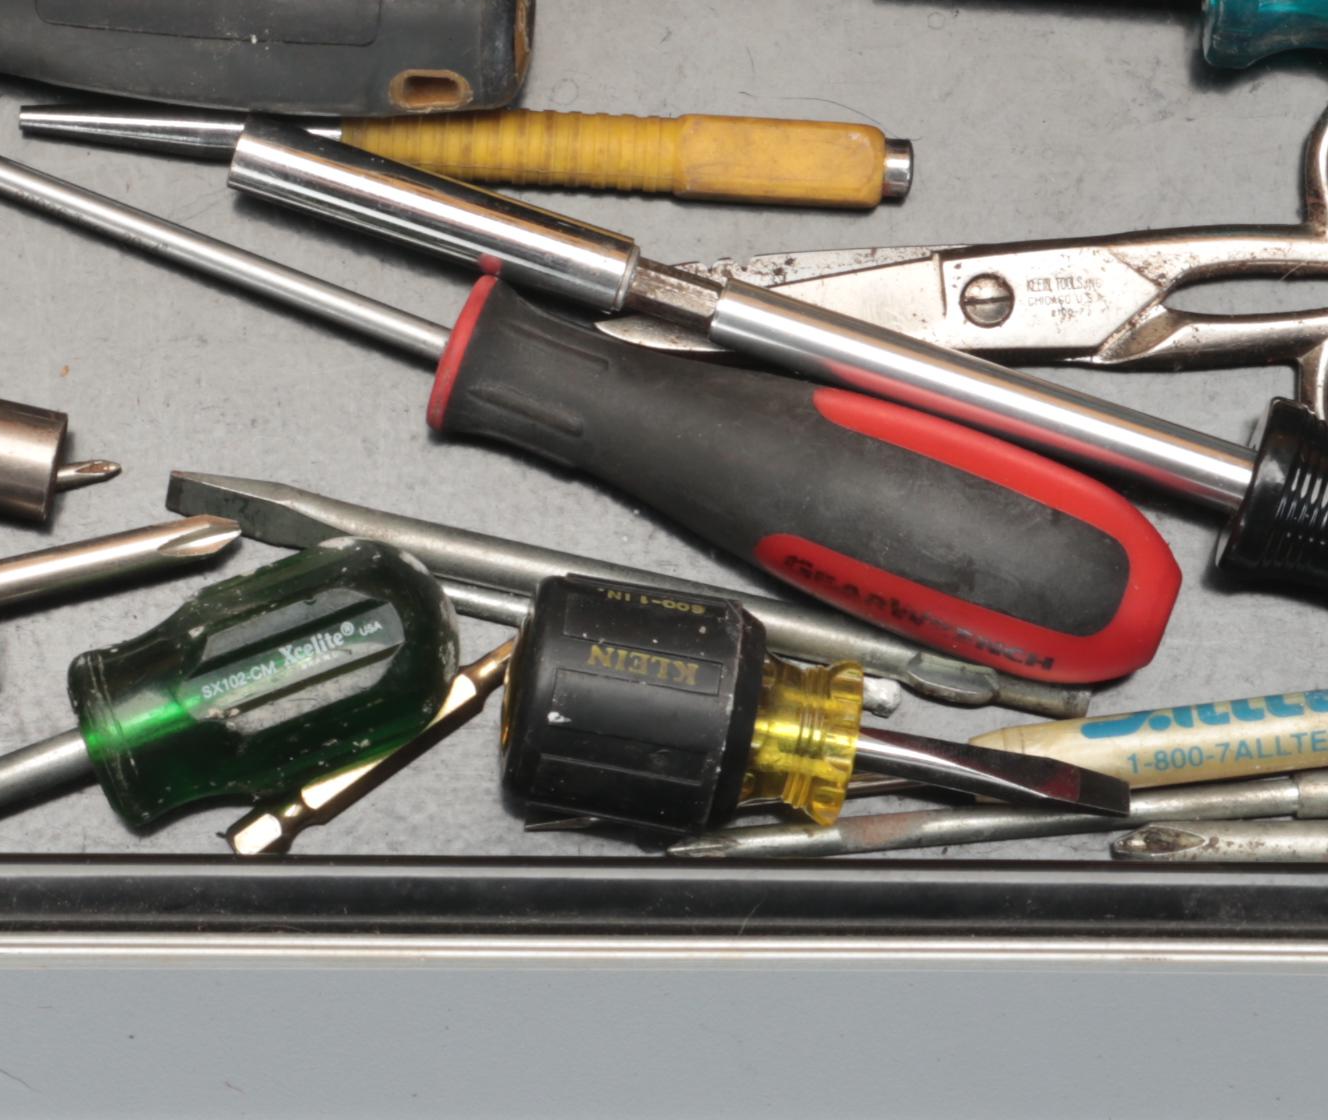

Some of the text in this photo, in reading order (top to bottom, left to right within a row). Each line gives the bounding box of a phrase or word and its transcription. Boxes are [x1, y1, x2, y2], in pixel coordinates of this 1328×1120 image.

[200, 660, 278, 699] SX102-CM
[358, 621, 383, 637] USA
[584, 644, 700, 686] KLEIN
